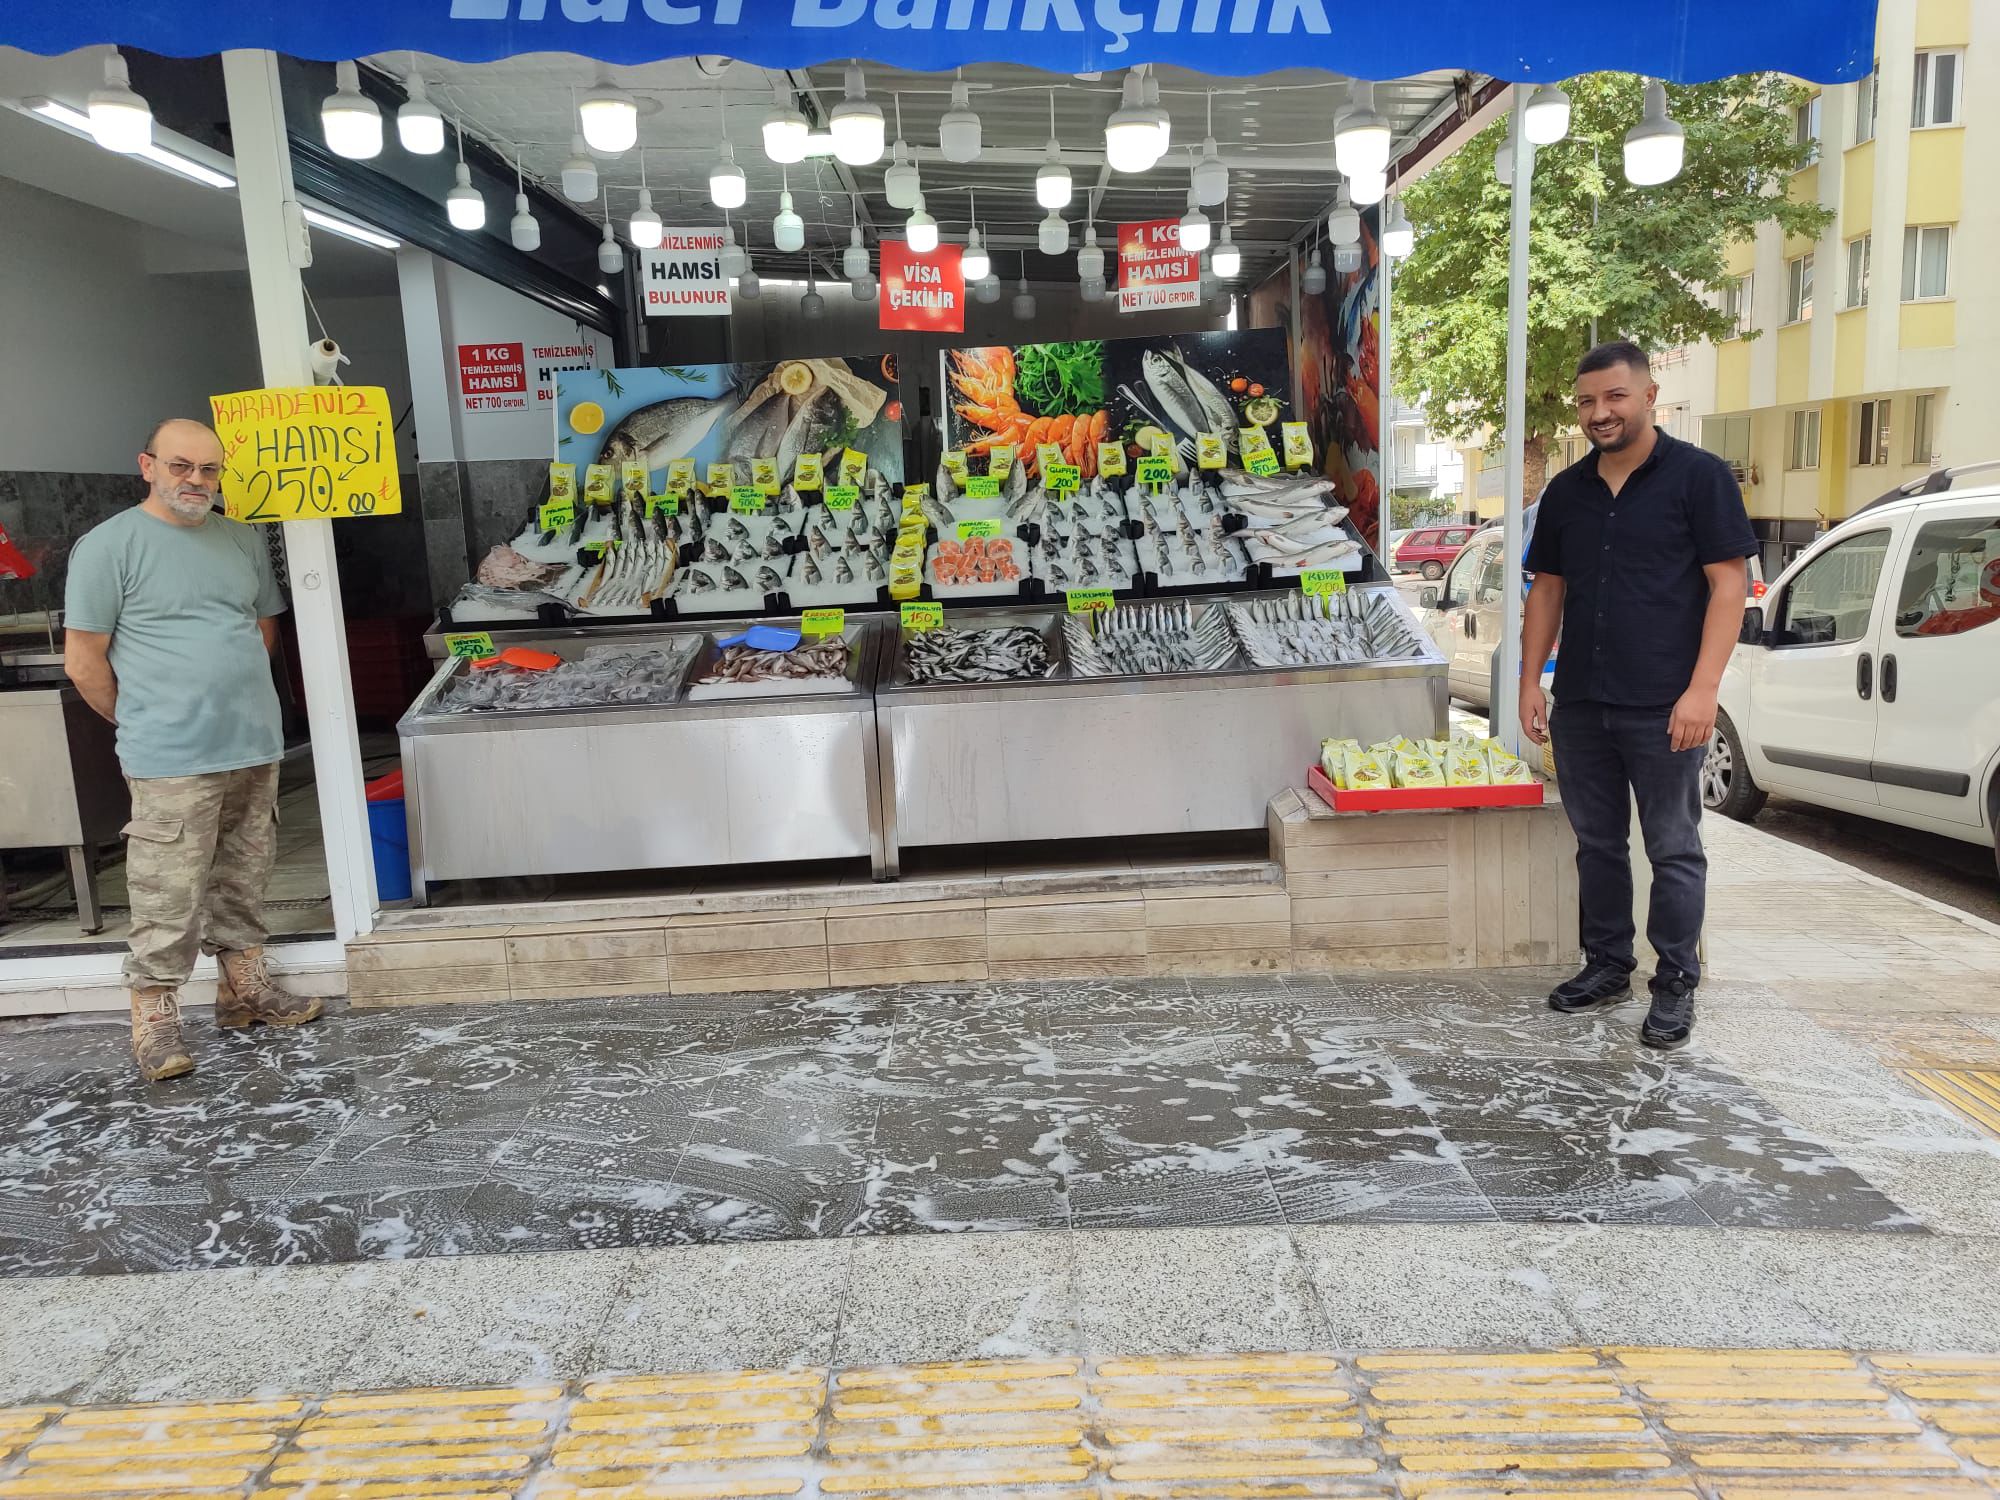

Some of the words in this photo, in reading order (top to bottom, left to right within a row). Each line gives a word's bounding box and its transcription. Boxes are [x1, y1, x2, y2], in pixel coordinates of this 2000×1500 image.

[1134, 228, 1144, 244] 1
[1152, 225, 1181, 243] KG
[651, 257, 721, 280] HAMSİ
[903, 261, 942, 284] VİSA
[1127, 258, 1189, 281] HAMSİ
[648, 290, 728, 305] BULUNUR
[889, 286, 955, 311] ÇEKİLİR
[1122, 292, 1143, 307] NET
[1147, 288, 1167, 305] 700
[471, 349, 480, 361] 1
[486, 347, 510, 360] KG
[461, 362, 523, 375] TEMİZLENMİŞ
[469, 374, 518, 390] HAMSİ
[466, 398, 483, 409] NET
[486, 396, 502, 408] 700
[255, 421, 383, 467] HAMSİ
[1052, 477, 1073, 488] 200
[910, 611, 933, 624] 150
